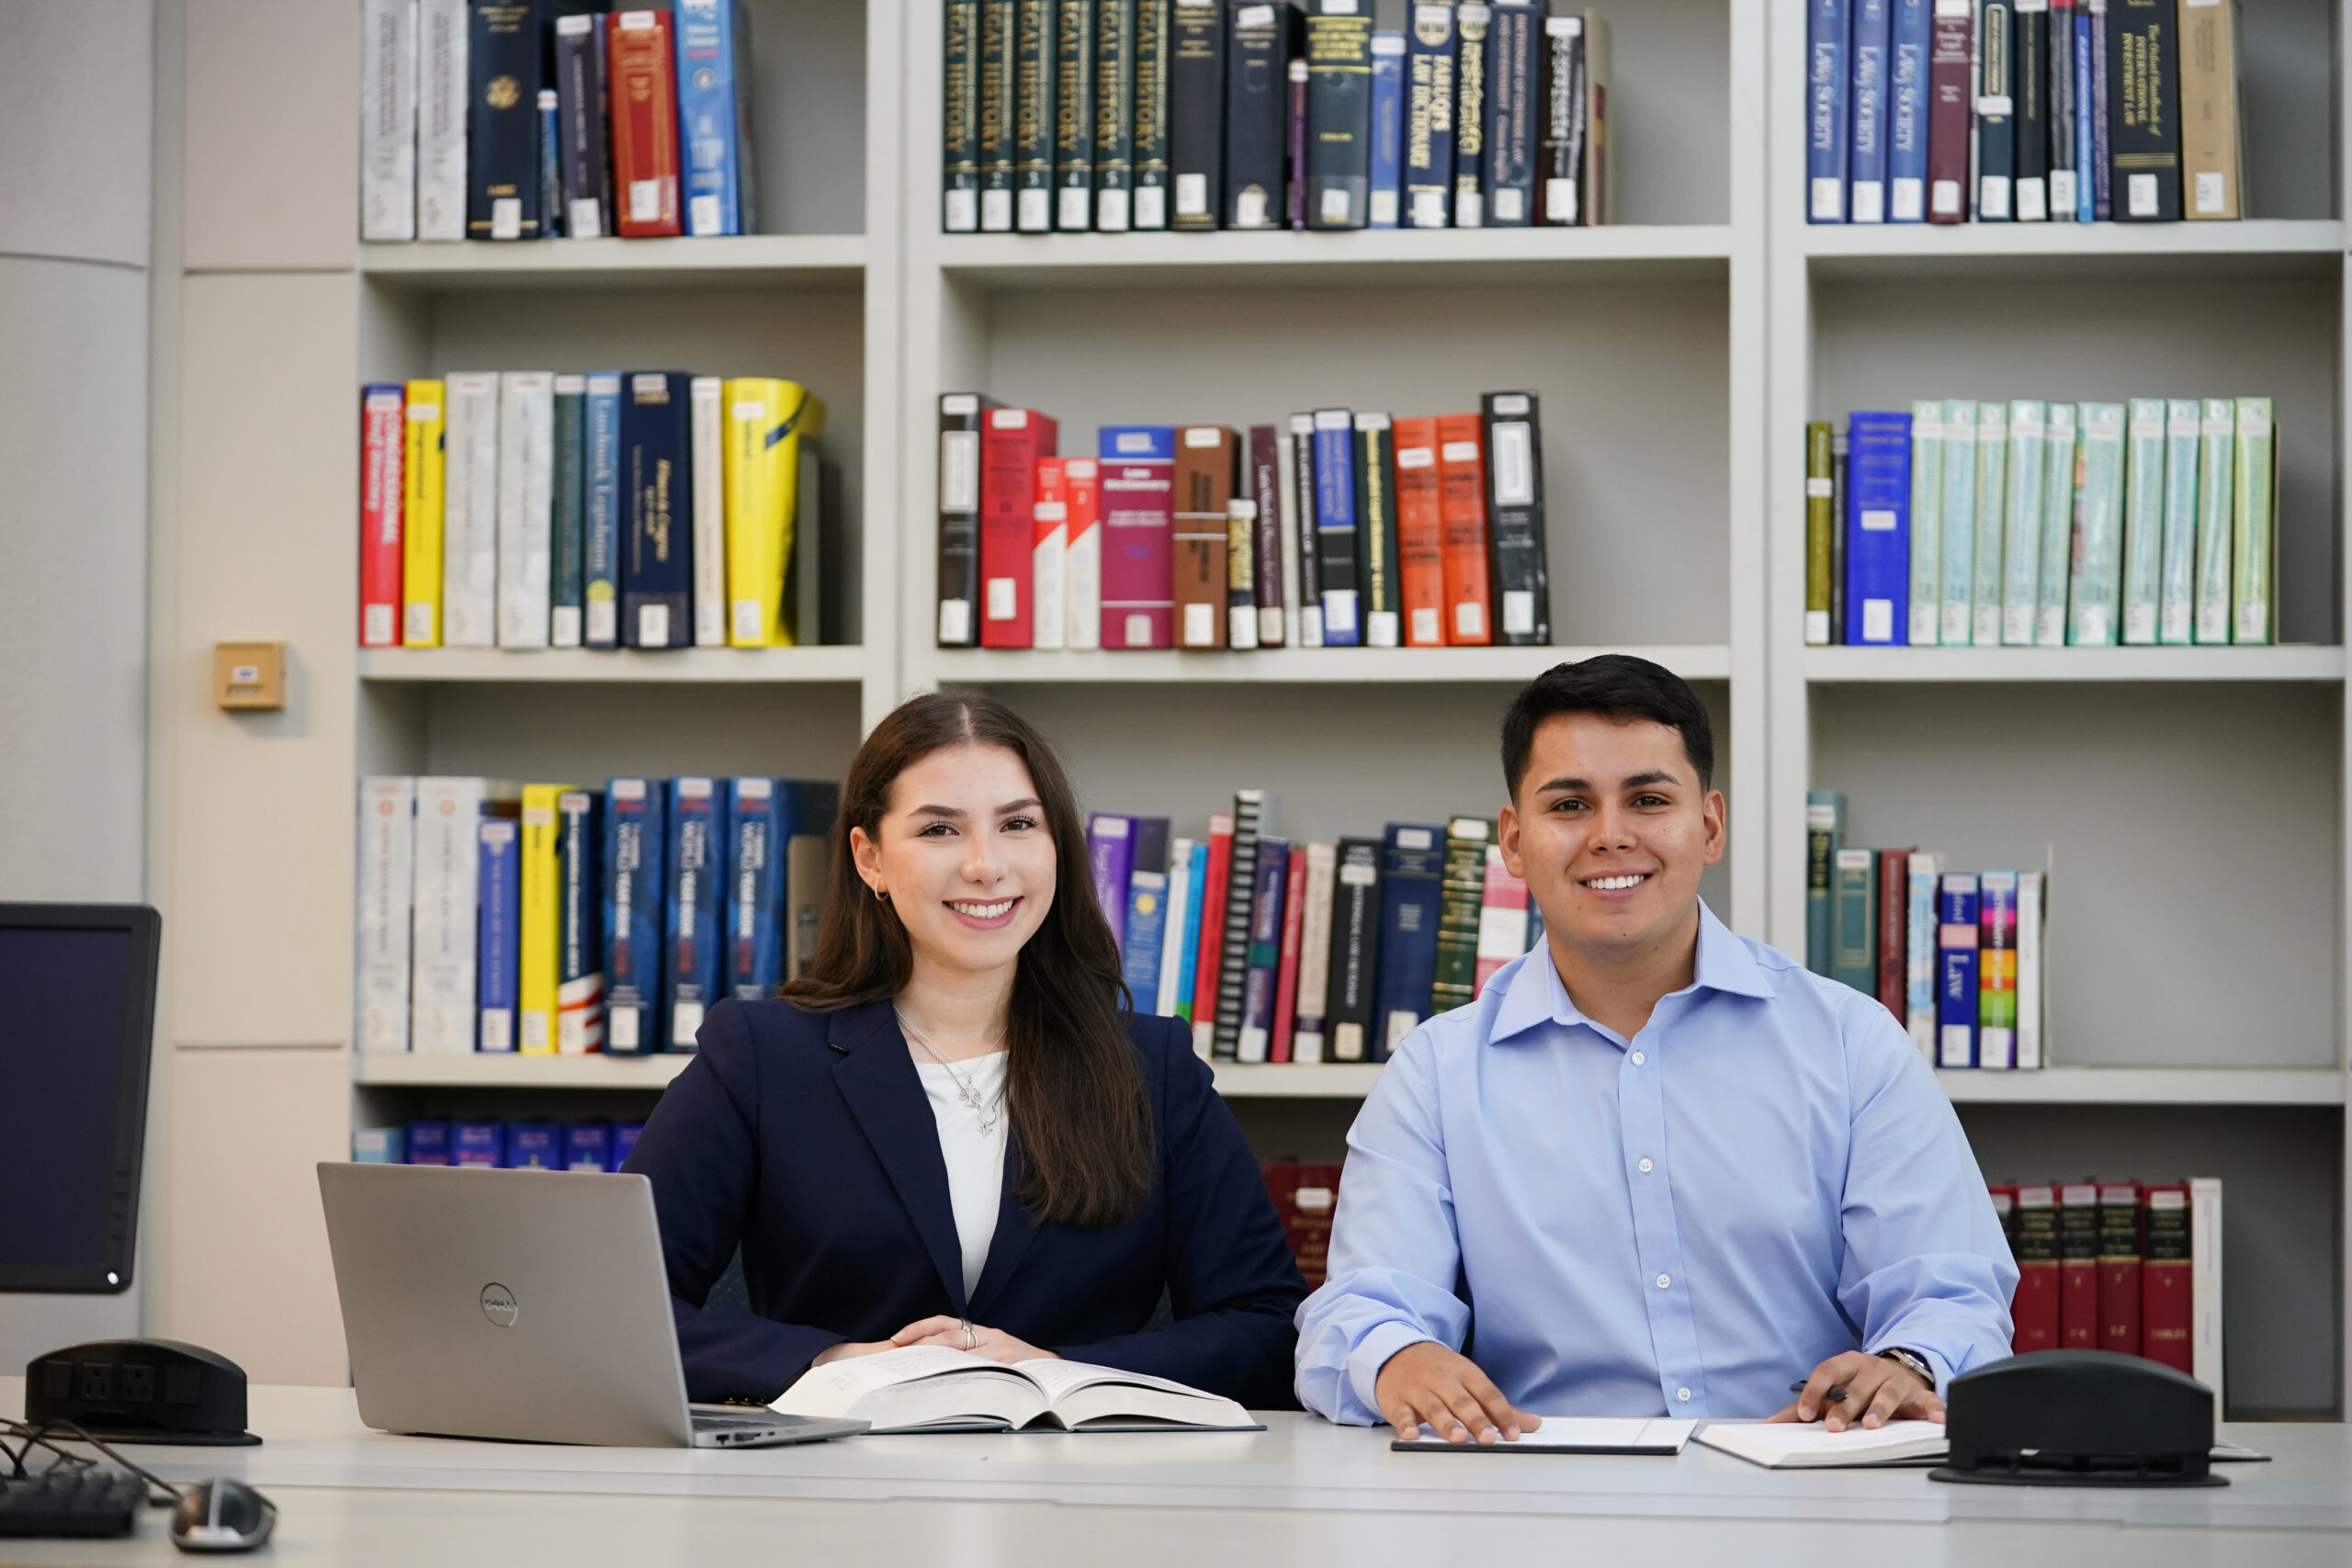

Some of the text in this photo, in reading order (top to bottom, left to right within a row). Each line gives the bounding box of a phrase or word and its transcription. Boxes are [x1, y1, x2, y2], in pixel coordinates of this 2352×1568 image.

[946, 4, 966, 152] EGAL HISTORY
[983, 3, 1002, 151] EGAL HISTORY
[1020, 2, 1038, 151] EGAL HISTORY
[1059, 2, 1079, 151] EGAL HISTORY
[1098, 1, 1117, 151] EGAL HISTORY
[1135, 1, 1156, 151] EGAL HISTORY
[2123, 33, 2135, 126] INVESTMENT LAW
[2137, 37, 2148, 122] INTERNATIONAL
[2148, 24, 2160, 135] The Oxford Handbook of
[1409, 54, 1430, 169] LAW DICTIONARY
[956, 174, 965, 187] 1
[990, 173, 1002, 186] 2
[1027, 172, 1039, 186] 3
[1067, 172, 1079, 185] 4
[1105, 171, 1118, 186] 5
[1144, 171, 1156, 185] 6
[383, 412, 401, 544] CONGRESSIONAL
[415, 422, 427, 499] ongressional
[593, 400, 613, 571] Landmark Legislation
[616, 822, 630, 871] WORLD
[681, 821, 695, 870] WORLD
[741, 821, 754, 871] WORLD
[616, 872, 630, 903] YEAR
[680, 871, 695, 902] YEAR
[741, 871, 755, 903] YEAR
[616, 904, 630, 939] BOOK
[679, 903, 694, 938] BOOK
[739, 904, 754, 939] BOOK
[1992, 890, 2007, 990] ICTIONARY OF LAW
[1948, 953, 1969, 1000] Law
[485, 1299, 514, 1312] DELL
